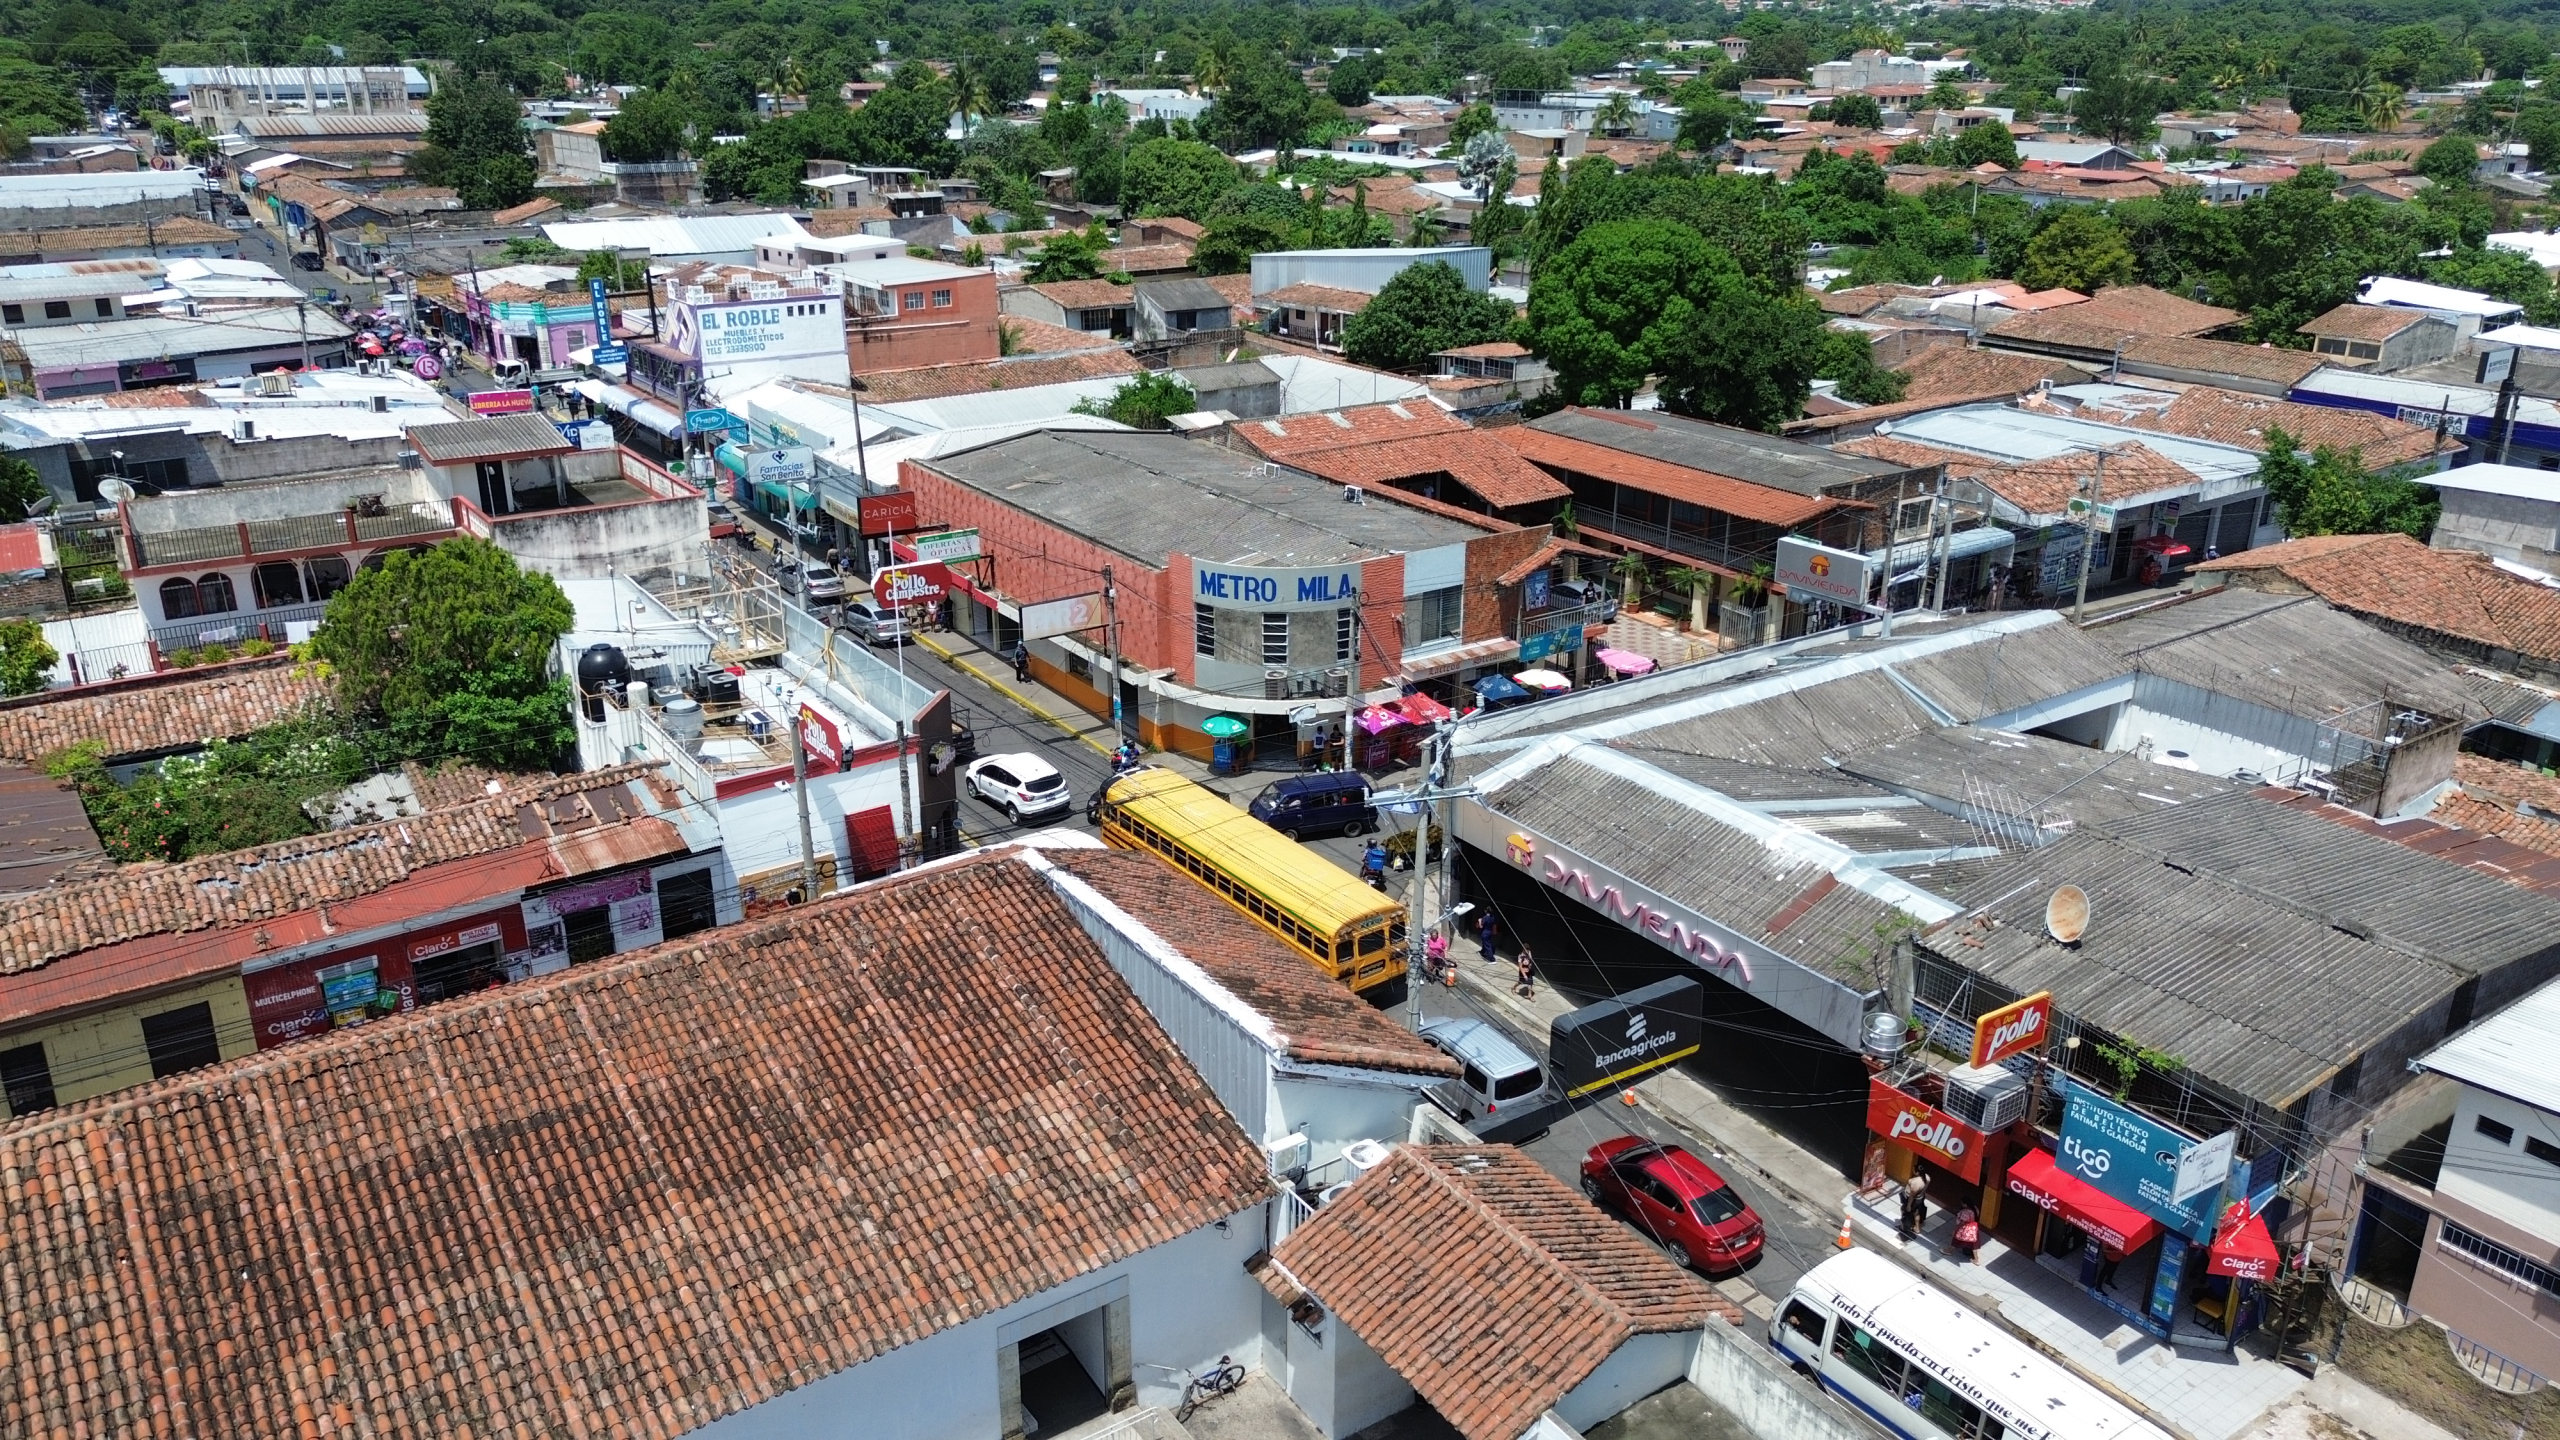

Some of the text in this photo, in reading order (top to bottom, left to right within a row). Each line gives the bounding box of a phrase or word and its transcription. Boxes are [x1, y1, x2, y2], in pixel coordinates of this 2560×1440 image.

[593, 282, 608, 341] EL ROBLE
[702, 308, 780, 330] EL ROBLE
[705, 333, 785, 347] ELECTRODOMESTICOS
[723, 328, 758, 337] MUEBLES
[471, 400, 501, 410] LIBRERIA
[760, 462, 804, 474] Farmacias
[761, 471, 805, 481] San Benito
[863, 505, 912, 519] CARICIA
[923, 540, 962, 550] OFERTAS
[885, 584, 940, 600] Campestre
[893, 574, 926, 590] Pollo
[1200, 569, 1352, 602] METRO MILA
[1779, 569, 1859, 597] DAVIVIENDA
[807, 717, 827, 746] Pollo
[803, 727, 836, 762] Campestre
[1542, 854, 1753, 983] DAVIVIENDA
[415, 941, 449, 956] Claro
[255, 985, 317, 1008] MULTICELPHONE
[267, 1015, 312, 1036] Claro
[2003, 1013, 2017, 1025] Don
[1986, 1006, 2041, 1061] pollo
[1595, 1030, 1677, 1069] Bancoagrícola
[1909, 1106, 1929, 1121] Don
[2072, 1103, 2147, 1146] DE BELLEZA
[2074, 1096, 2149, 1138] INSTITUTO TÉCNICO
[1890, 1110, 1965, 1156] pollo
[2106, 1129, 2147, 1154] GLAMOUR
[2064, 1135, 2111, 1172] tigo
[2010, 1179, 2052, 1210] Claro
[2138, 1183, 2161, 1198] SALÓN
[2161, 1194, 2170, 1203] DE
[2169, 1205, 2204, 1228] GLAMOUR
[2093, 1230, 2124, 1250] GLAMOUR
[2222, 1257, 2259, 1270] Claro
[1830, 1292, 1861, 1323] Todo
[1862, 1312, 1877, 1329] lo
[1876, 1326, 1920, 1358] puedo
[1920, 1354, 1940, 1371] en
[1940, 1365, 1983, 1399] Cristo
[1985, 1397, 2012, 1420] que
[2013, 1417, 2038, 1436] me
